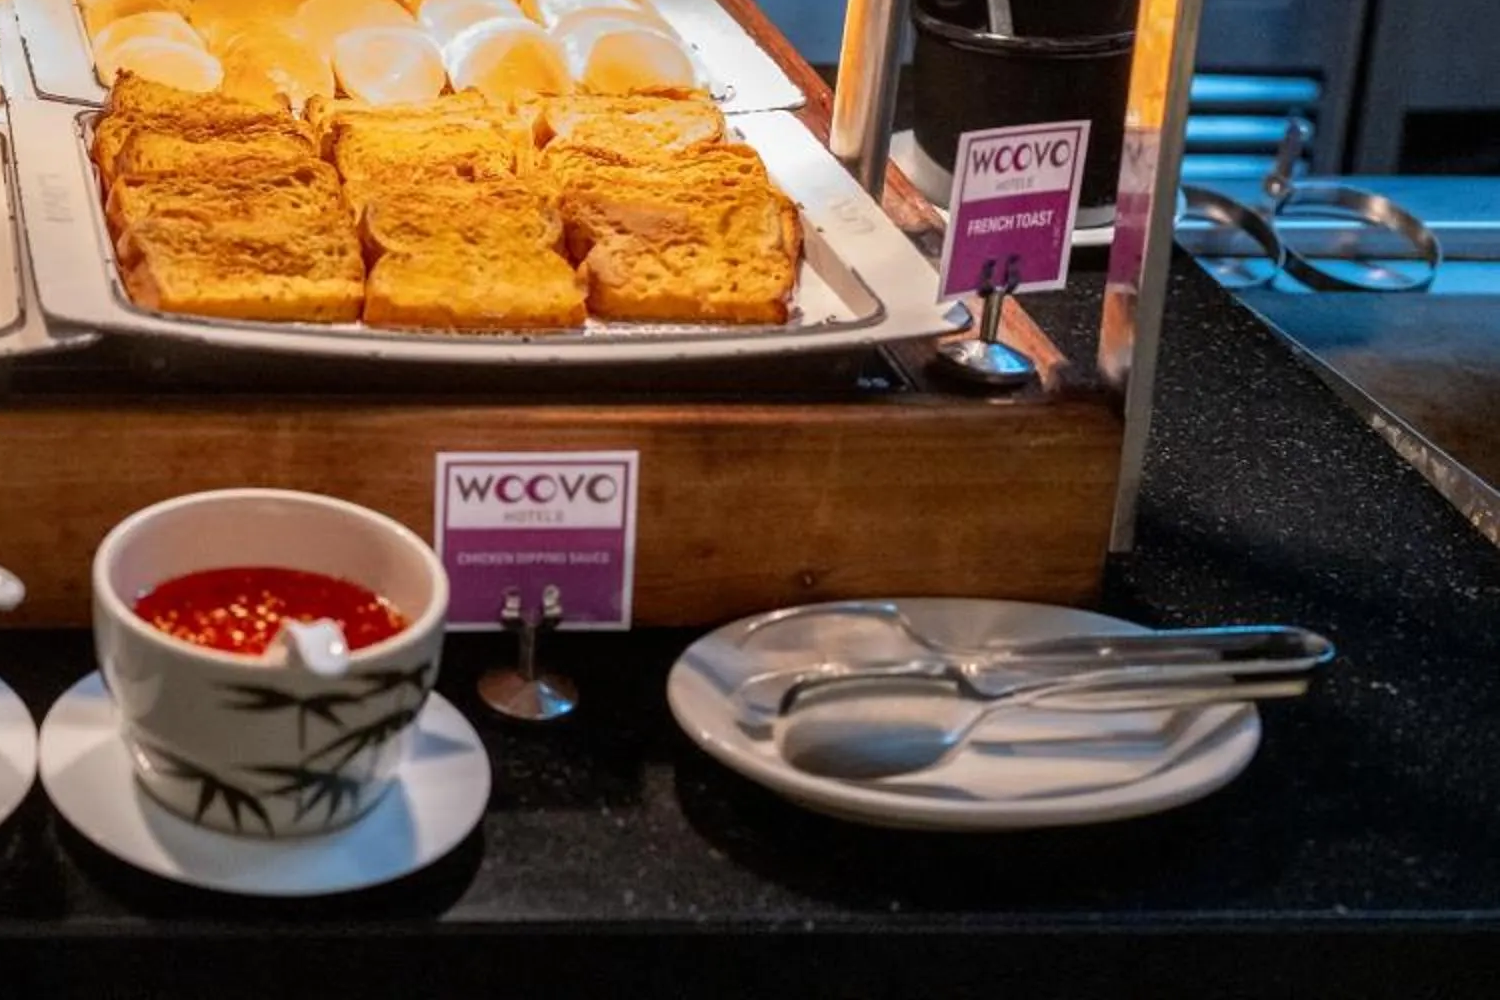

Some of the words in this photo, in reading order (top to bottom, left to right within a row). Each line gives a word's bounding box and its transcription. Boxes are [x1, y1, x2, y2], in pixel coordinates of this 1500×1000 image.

[972, 139, 1070, 174] WOOVO
[967, 215, 1014, 237] FRENCH
[1015, 209, 1055, 229] TOAST
[455, 474, 617, 503] WOOVO
[457, 551, 514, 566] CHICKEN
[515, 551, 567, 565] DIPPING
[569, 551, 610, 565] SAUCE
